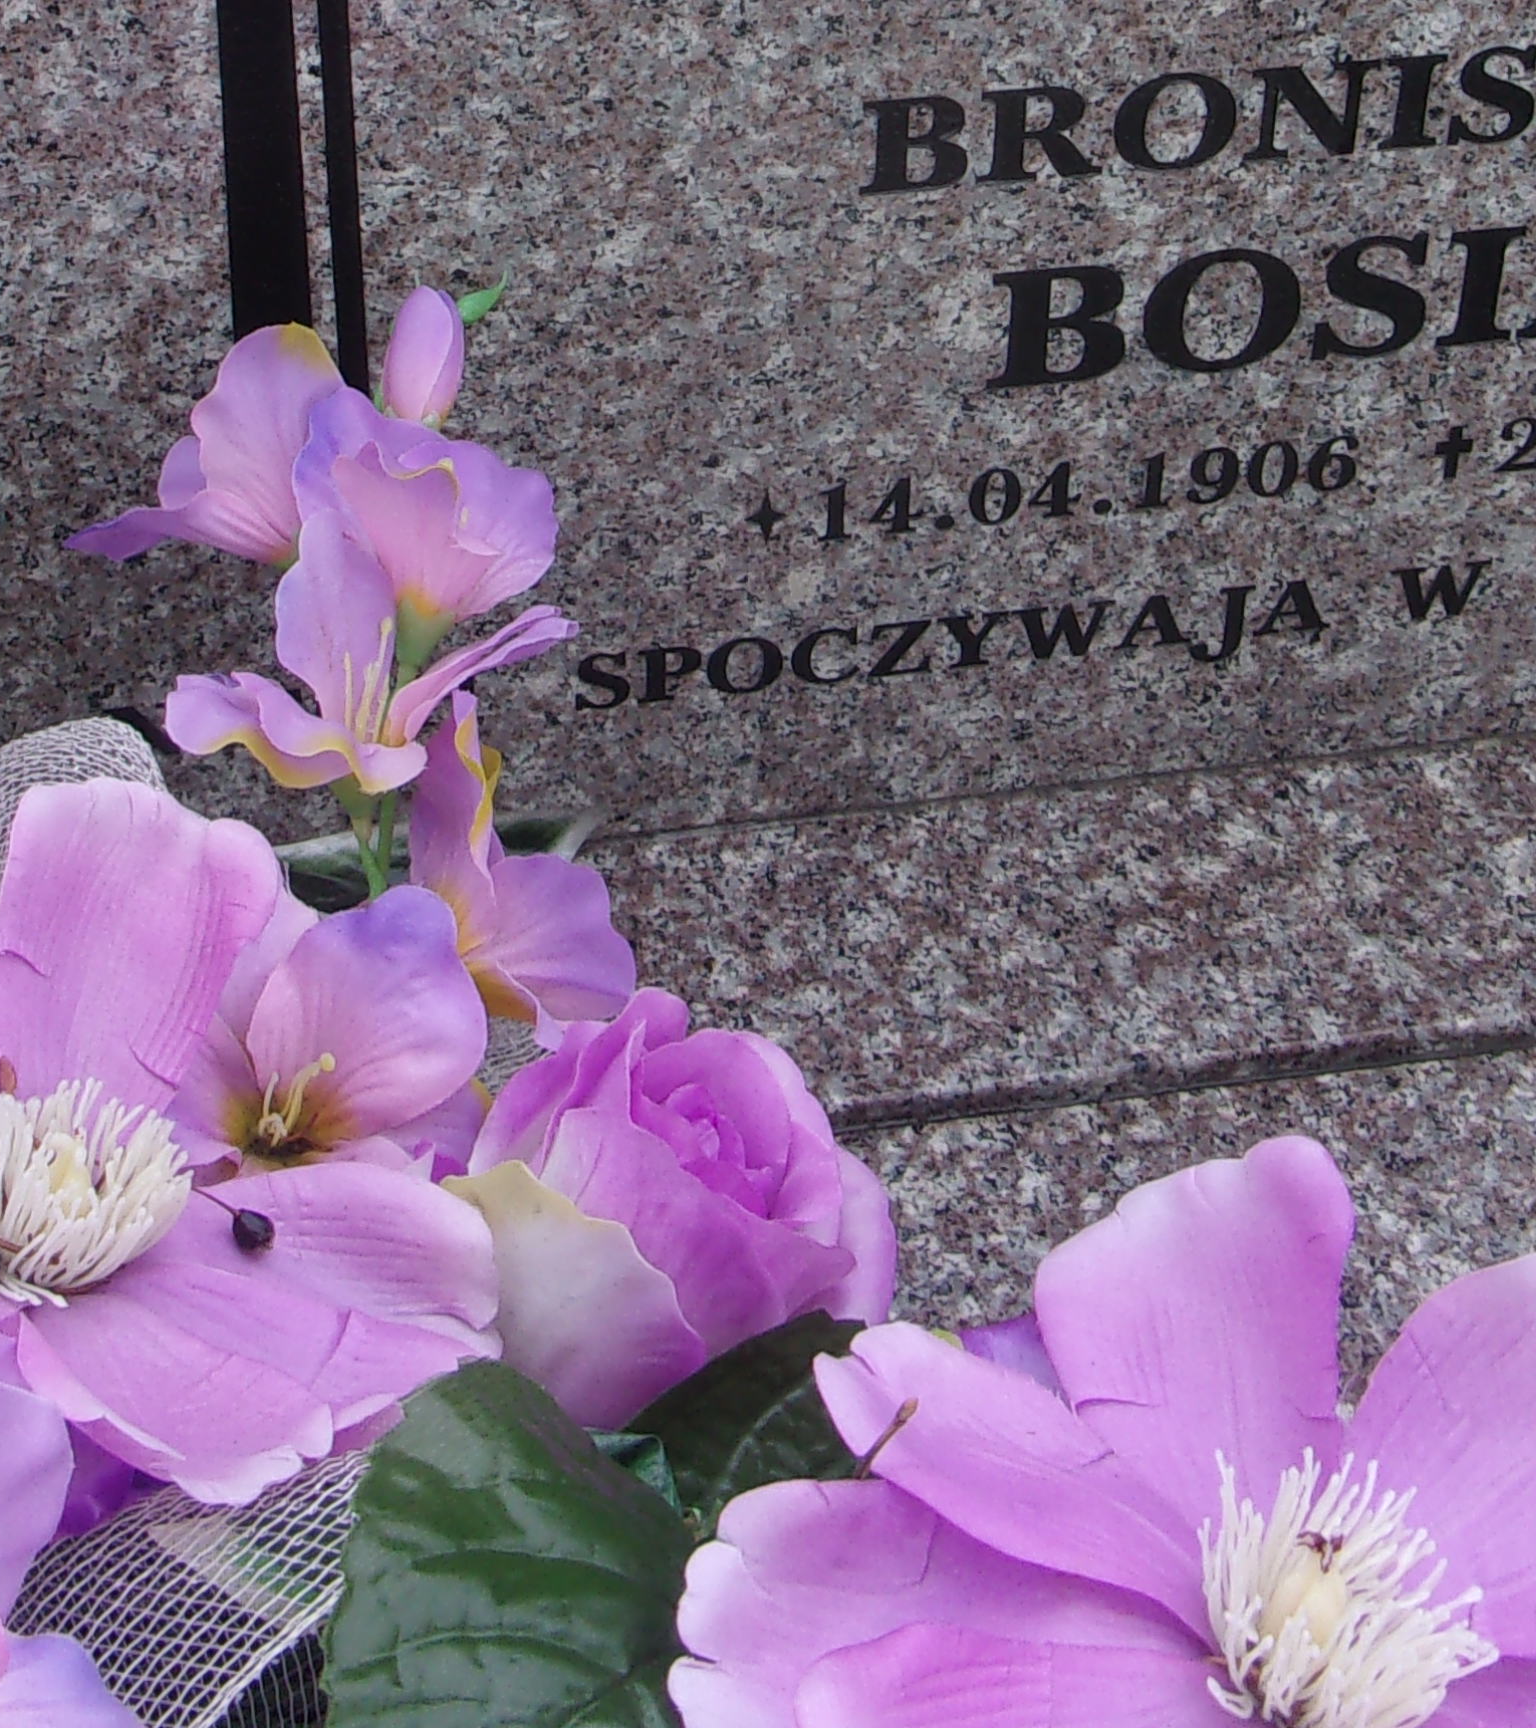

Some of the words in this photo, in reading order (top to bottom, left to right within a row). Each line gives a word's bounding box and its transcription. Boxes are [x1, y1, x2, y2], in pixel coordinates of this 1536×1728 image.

[816, 434, 1360, 546] 14.04.1906
[574, 579, 1329, 711] SPOCZYWAJĄ
[1395, 560, 1490, 622] W
